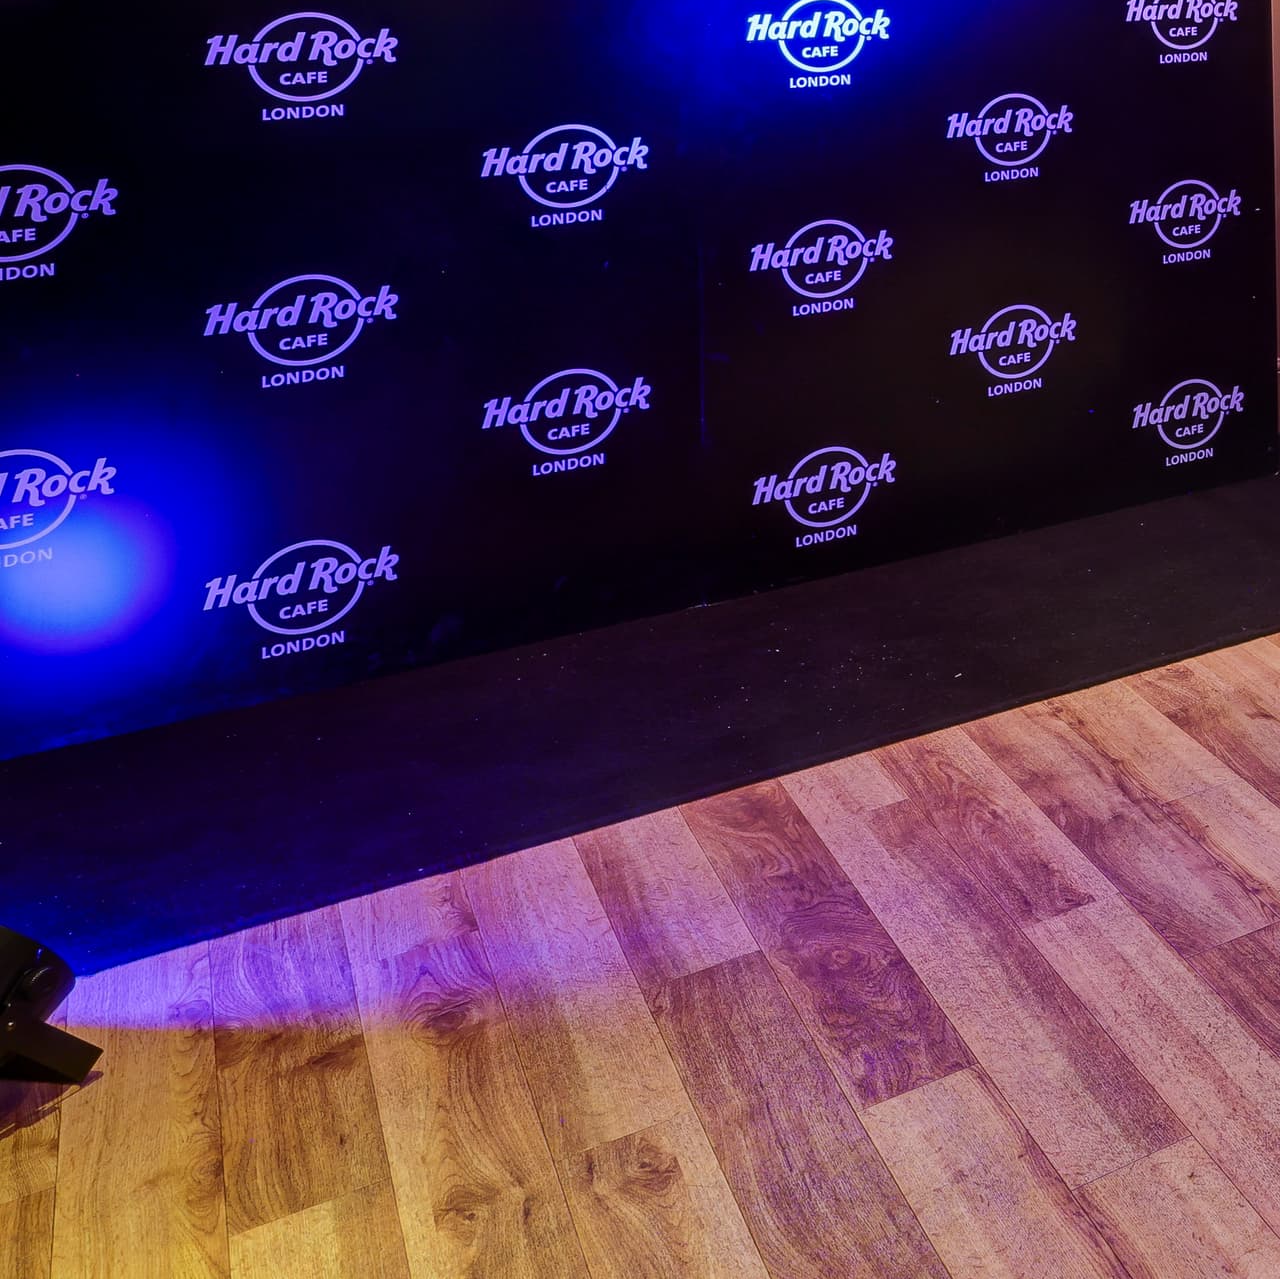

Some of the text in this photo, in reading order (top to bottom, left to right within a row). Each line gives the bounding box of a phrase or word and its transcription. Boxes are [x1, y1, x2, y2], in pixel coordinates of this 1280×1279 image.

[746, 8, 891, 43] Hard Rock
[1168, 26, 1198, 38] CAFE
[204, 27, 399, 67] Hard Rock
[802, 45, 839, 59] CAFE
[1159, 51, 1208, 64] LONDON
[279, 70, 328, 86] CAFE
[789, 74, 851, 89] LONDON
[262, 103, 344, 121] LONDON
[946, 104, 1074, 139] Hard Rock
[480, 136, 650, 178] Hard Rock
[995, 140, 1028, 154] CAFE
[984, 166, 1039, 183] LONDON
[545, 178, 589, 194] CAFE
[13, 177, 119, 223] Rock
[1128, 188, 1242, 225] Hard Rock
[531, 208, 603, 228] LONDON
[0, 227, 37, 244] AFE
[1172, 223, 1201, 237] CAFE
[749, 229, 894, 272] Hard Rock
[1162, 248, 1211, 265] LONDON
[805, 269, 842, 285] CAFE
[203, 284, 399, 337] Hard Rock
[792, 297, 854, 317] LONDON
[278, 332, 328, 351] CAFE
[949, 312, 1077, 356] Hard Rock
[998, 351, 1031, 367] CAFE
[261, 365, 345, 389] LONDON
[987, 377, 1042, 397] LONDON
[481, 376, 652, 430] Hard Rock
[1131, 384, 1245, 430] Hard Rock
[547, 422, 590, 441] CAFE
[1175, 422, 1204, 438] CAFE
[532, 452, 605, 477] LONDON
[1165, 447, 1214, 467] LONDON
[11, 456, 118, 508] Rock
[751, 452, 897, 506] Hard Rock
[808, 496, 845, 515] CAFE
[0, 512, 35, 532] AFE
[795, 524, 857, 548] LONDON
[202, 545, 400, 612] Hard Rock
[279, 598, 329, 620] CAFE
[261, 630, 345, 660] LONDON
